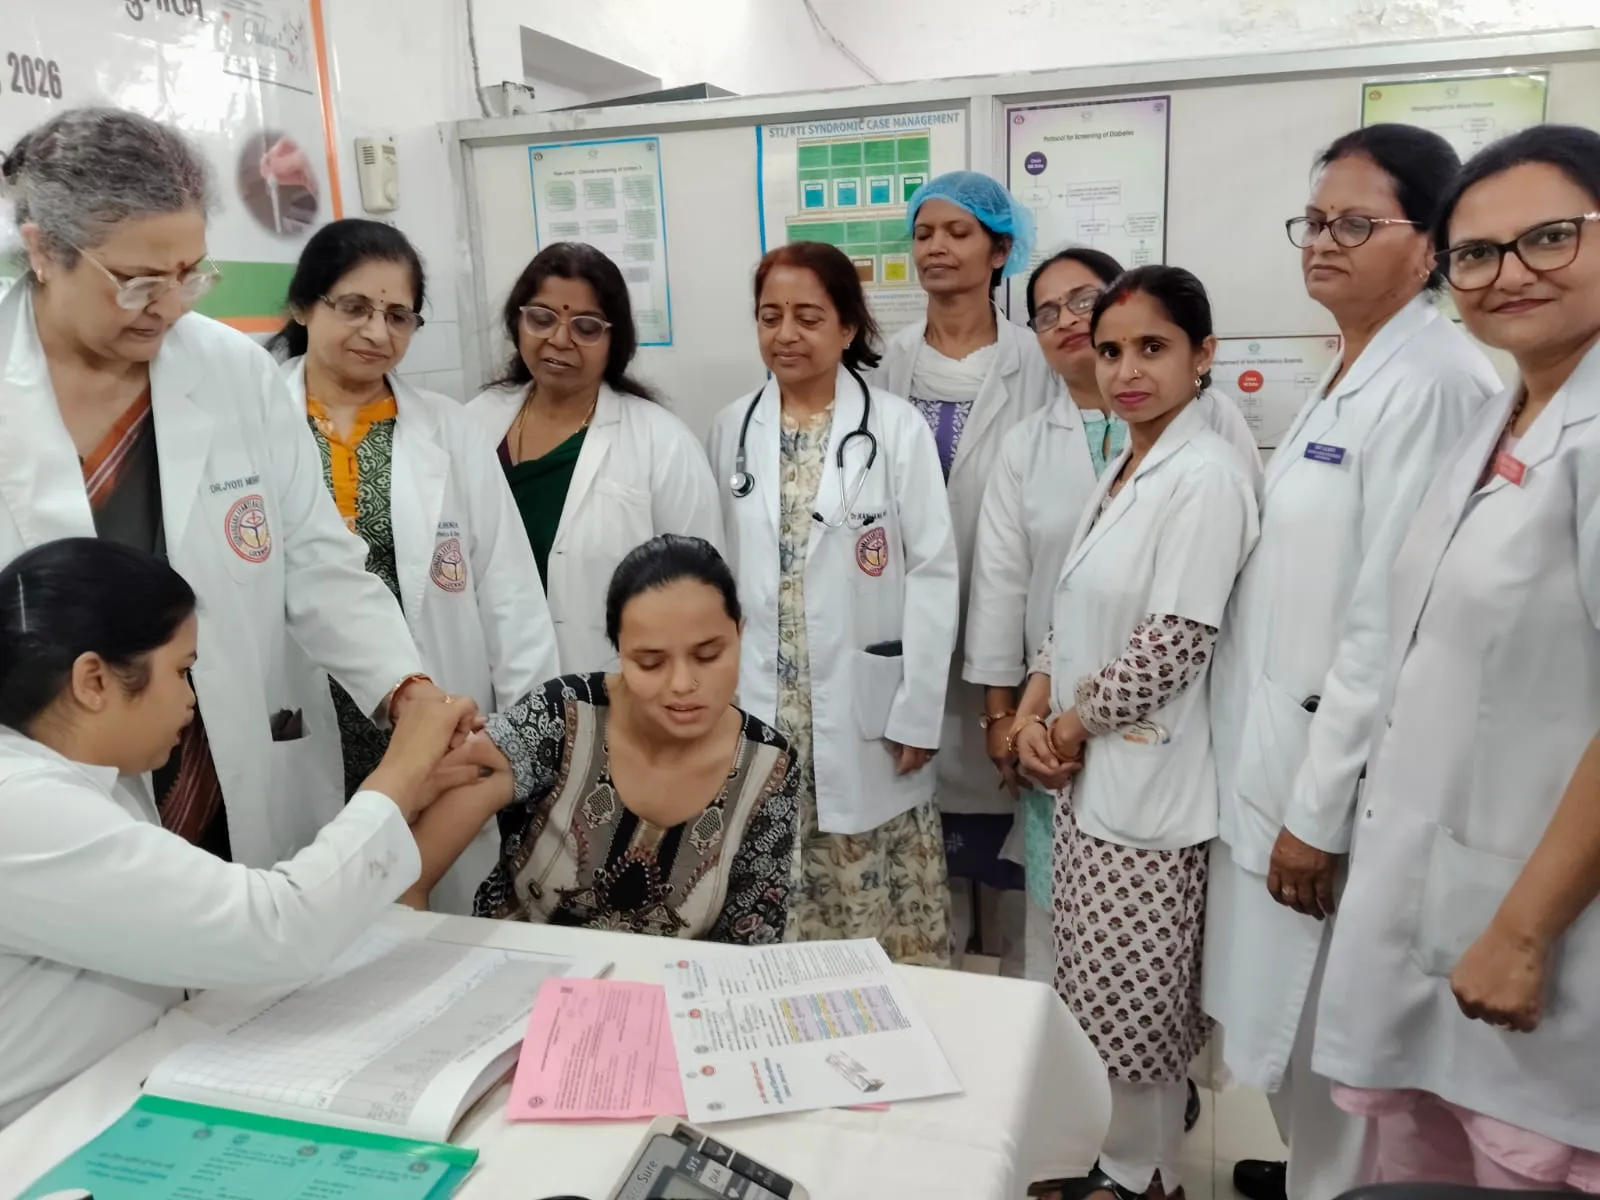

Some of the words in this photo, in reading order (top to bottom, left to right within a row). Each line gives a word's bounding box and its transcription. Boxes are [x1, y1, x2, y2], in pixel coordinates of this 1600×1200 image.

[7, 51, 62, 99] 2026
[769, 125, 806, 138] STI/RTI
[808, 118, 864, 135] SYNDROMIC
[867, 117, 890, 130] CASE
[893, 112, 960, 128] MANAGEMENT
[686, 1155, 700, 1172] SYS
[709, 1168, 721, 1184] DIA
